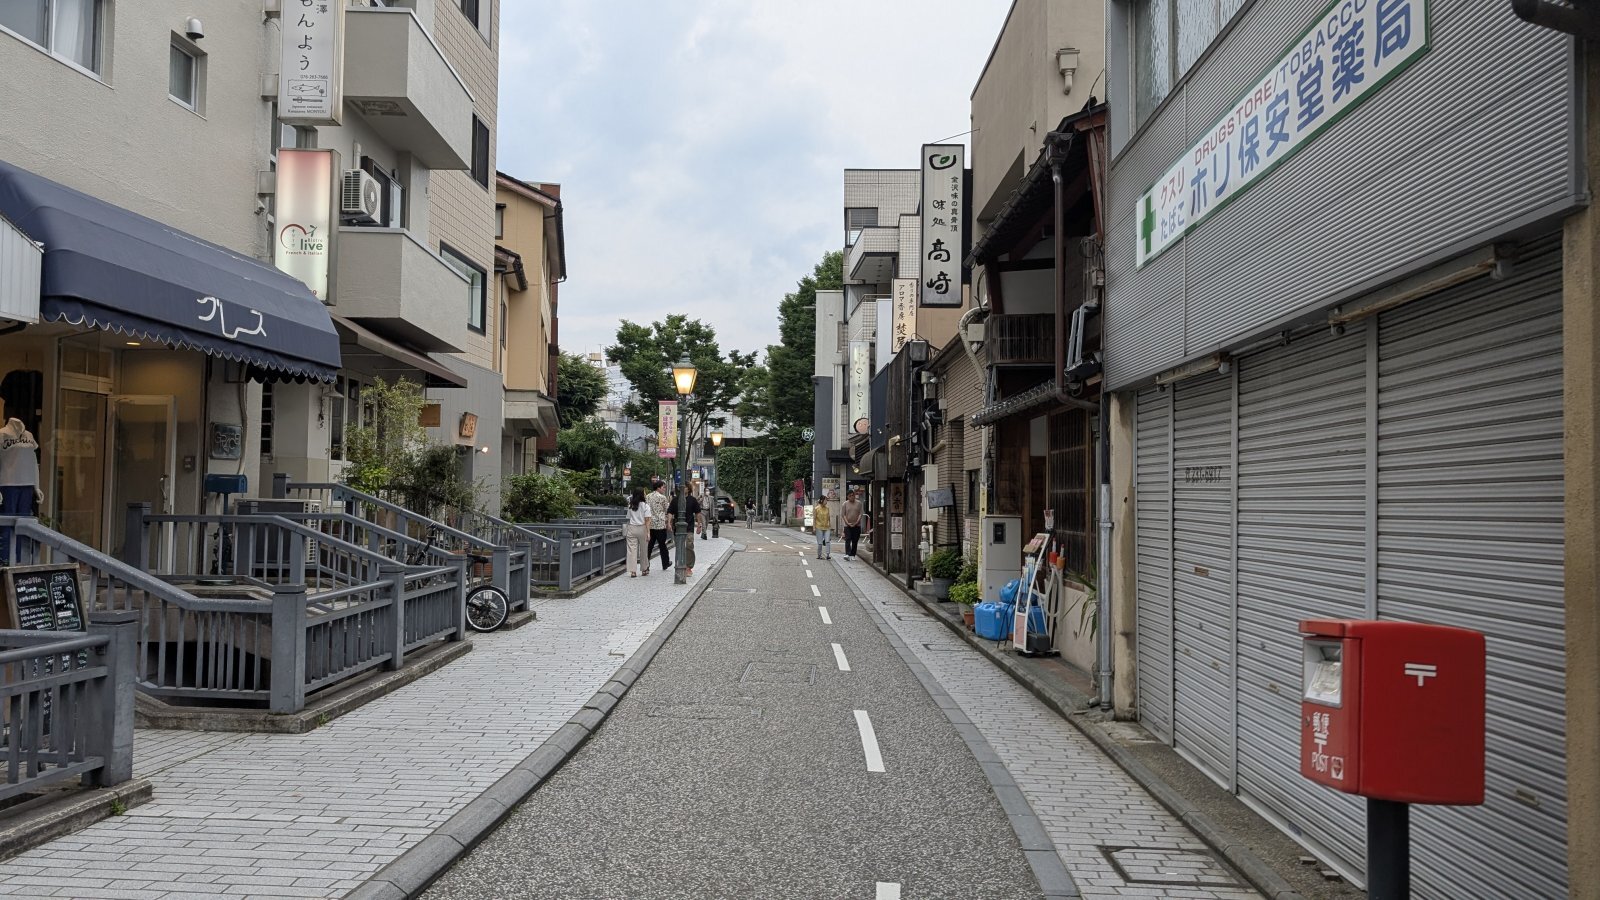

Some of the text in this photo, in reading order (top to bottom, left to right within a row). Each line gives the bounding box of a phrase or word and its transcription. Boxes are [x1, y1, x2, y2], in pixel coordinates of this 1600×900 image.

[1190, 0, 1411, 217] ホリ保安堂薬局
[951, 175, 959, 233] 金沢味の真骨頂
[1160, 166, 1185, 210] クスリ
[1160, 201, 1185, 242] たばこ
[1311, 751, 1330, 773] POST
